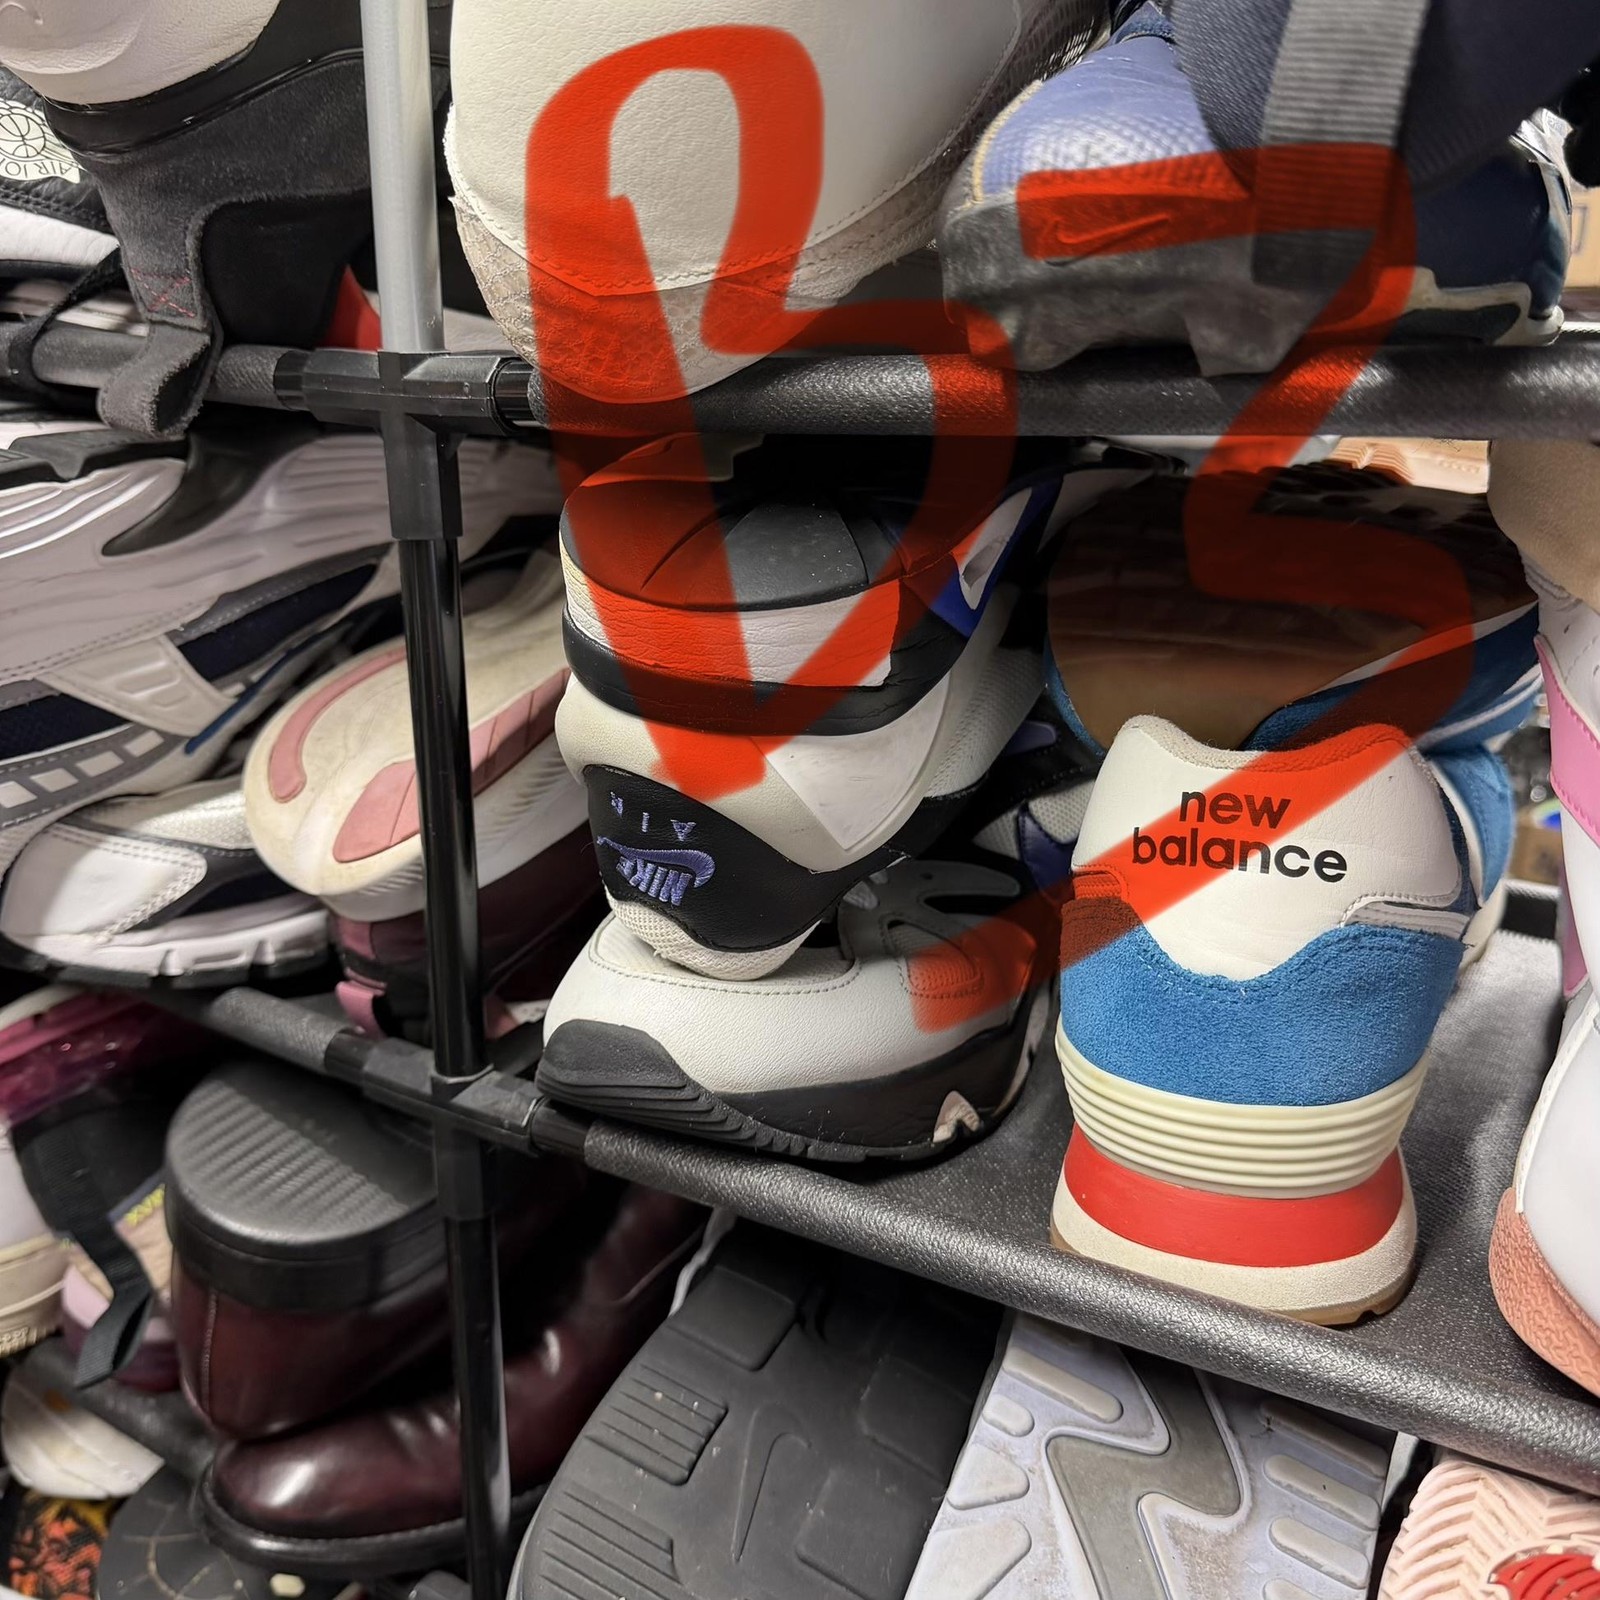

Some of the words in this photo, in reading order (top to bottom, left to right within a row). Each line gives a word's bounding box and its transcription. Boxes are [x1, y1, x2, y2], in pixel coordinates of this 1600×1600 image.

[33, 161, 72, 175] AIR
[610, 791, 697, 841] AIR
[1179, 791, 1291, 829] new
[1133, 826, 1348, 883] balance
[616, 856, 693, 907] NIKE
